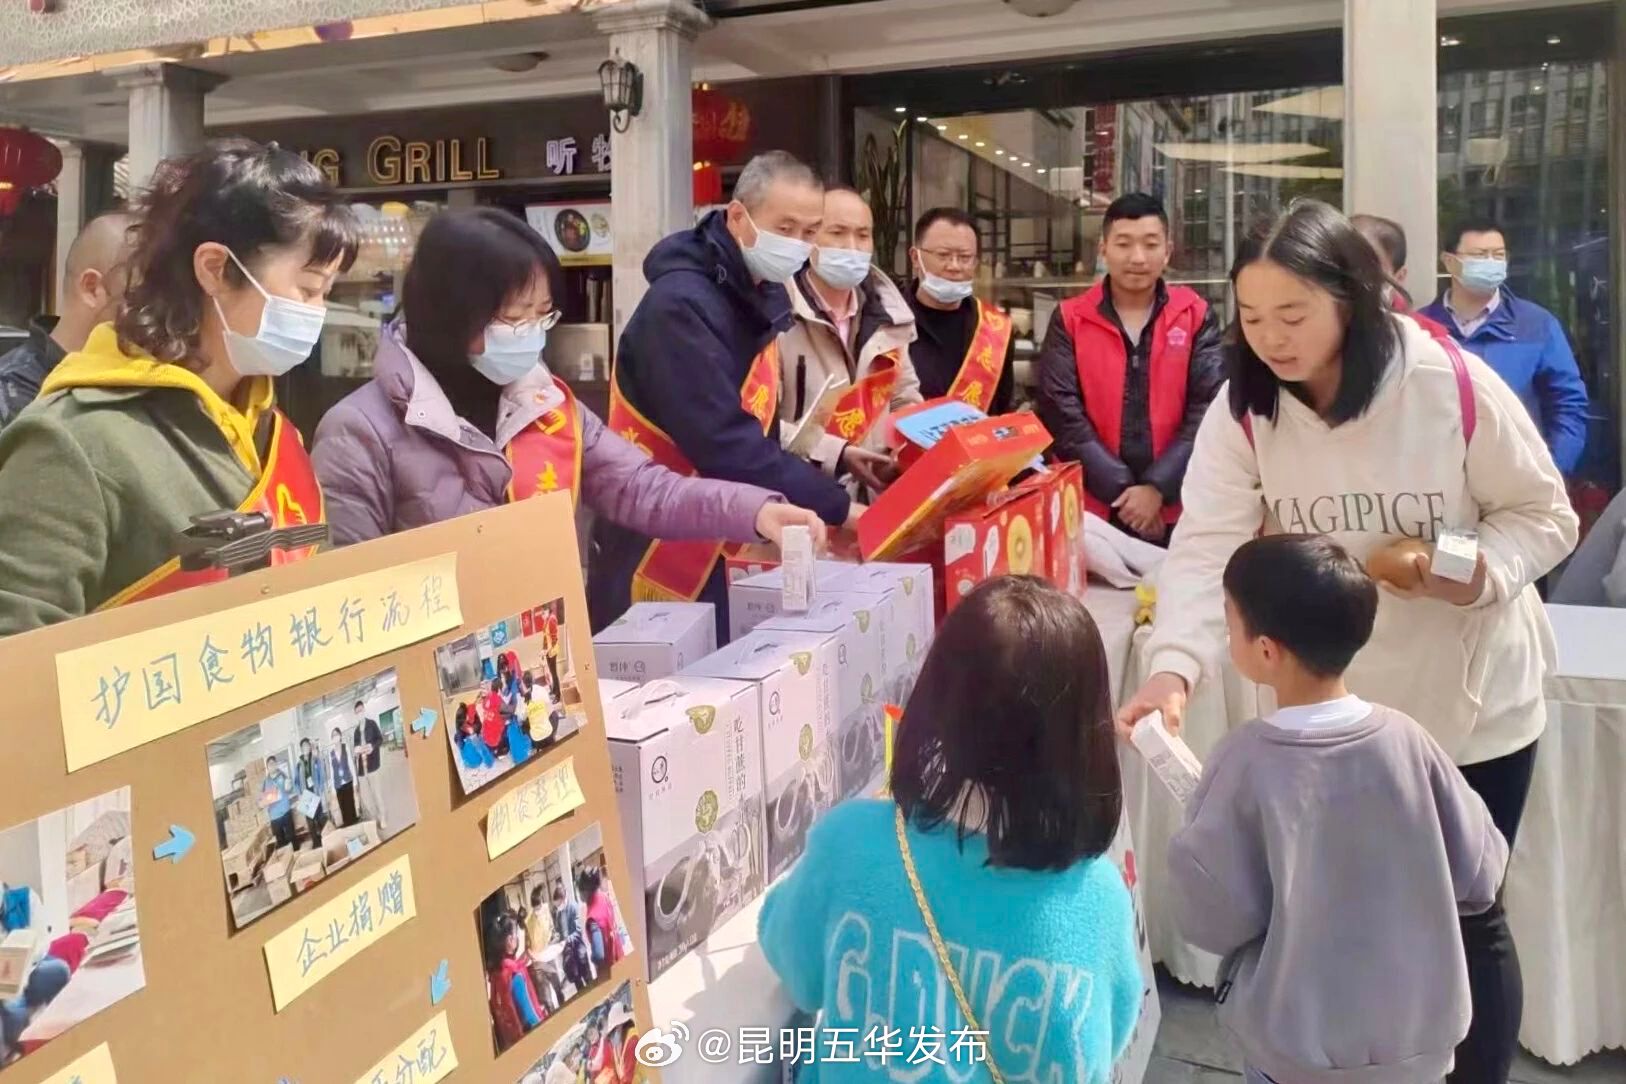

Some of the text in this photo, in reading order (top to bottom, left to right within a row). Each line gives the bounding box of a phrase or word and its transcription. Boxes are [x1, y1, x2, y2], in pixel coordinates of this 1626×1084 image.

[366, 135, 499, 184] GRILL
[90, 574, 451, 730] 护国食物银行流程
[297, 870, 404, 977] 企业捐赠
